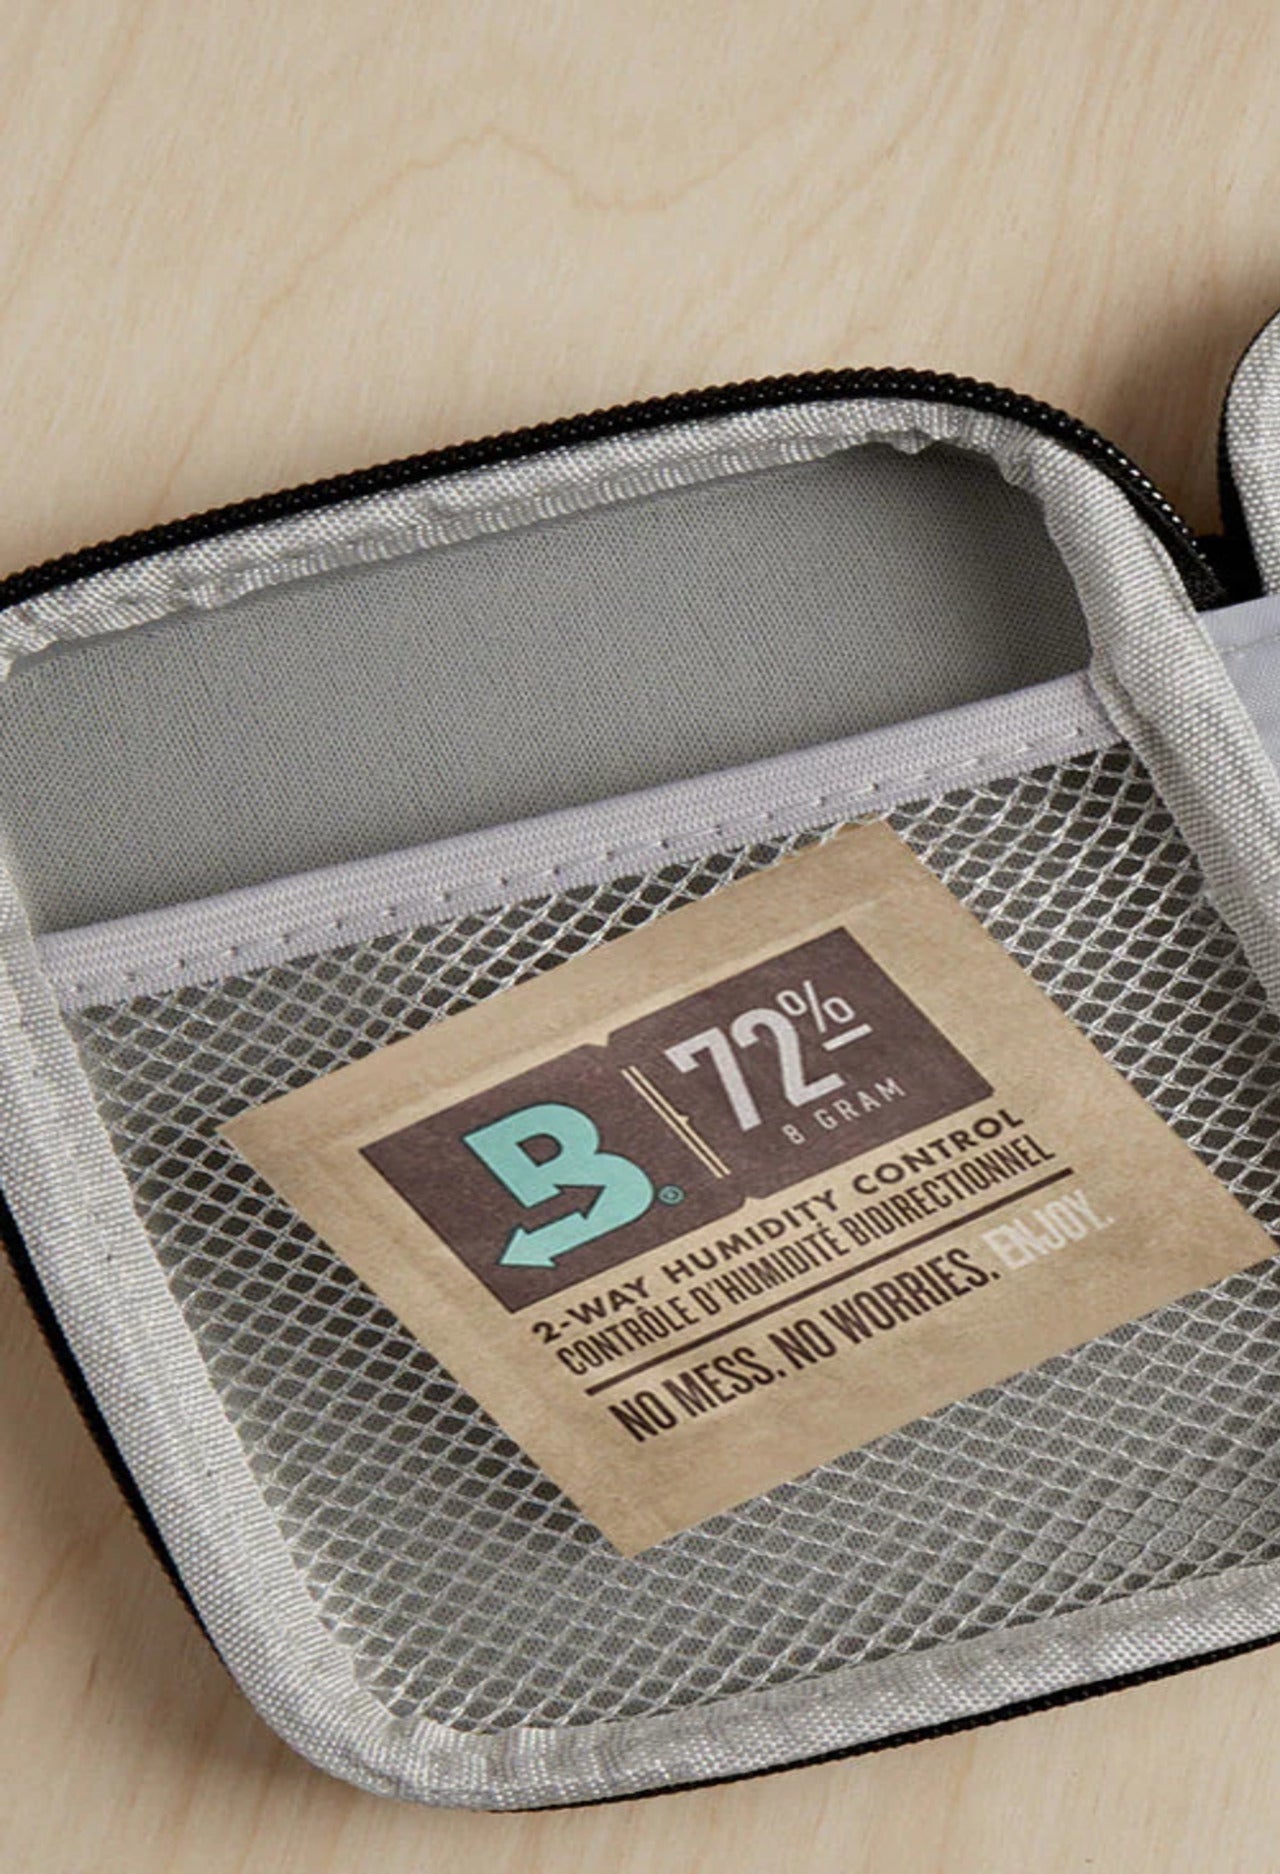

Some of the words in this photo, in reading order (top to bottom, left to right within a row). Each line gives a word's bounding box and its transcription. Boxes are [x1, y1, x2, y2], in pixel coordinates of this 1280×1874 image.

[664, 980, 856, 1132] 72%
[781, 1123, 805, 1145] 8
[813, 1077, 906, 1130] GRAM
[532, 1275, 651, 1344] 2-WAY
[661, 1189, 838, 1284] HUMIDITY
[852, 1108, 1024, 1195] CONTROL
[556, 1296, 700, 1376] CONTRÔLE
[689, 1221, 850, 1316] D'HUMIDITÉ
[839, 1134, 1056, 1247] BIDIRECTIONNEL
[608, 1390, 678, 1442] NO
[661, 1346, 788, 1418] MESS.
[768, 1318, 838, 1370] NO
[820, 1248, 1001, 1346] WORRIES.
[981, 1188, 1115, 1270] ENJOY.
